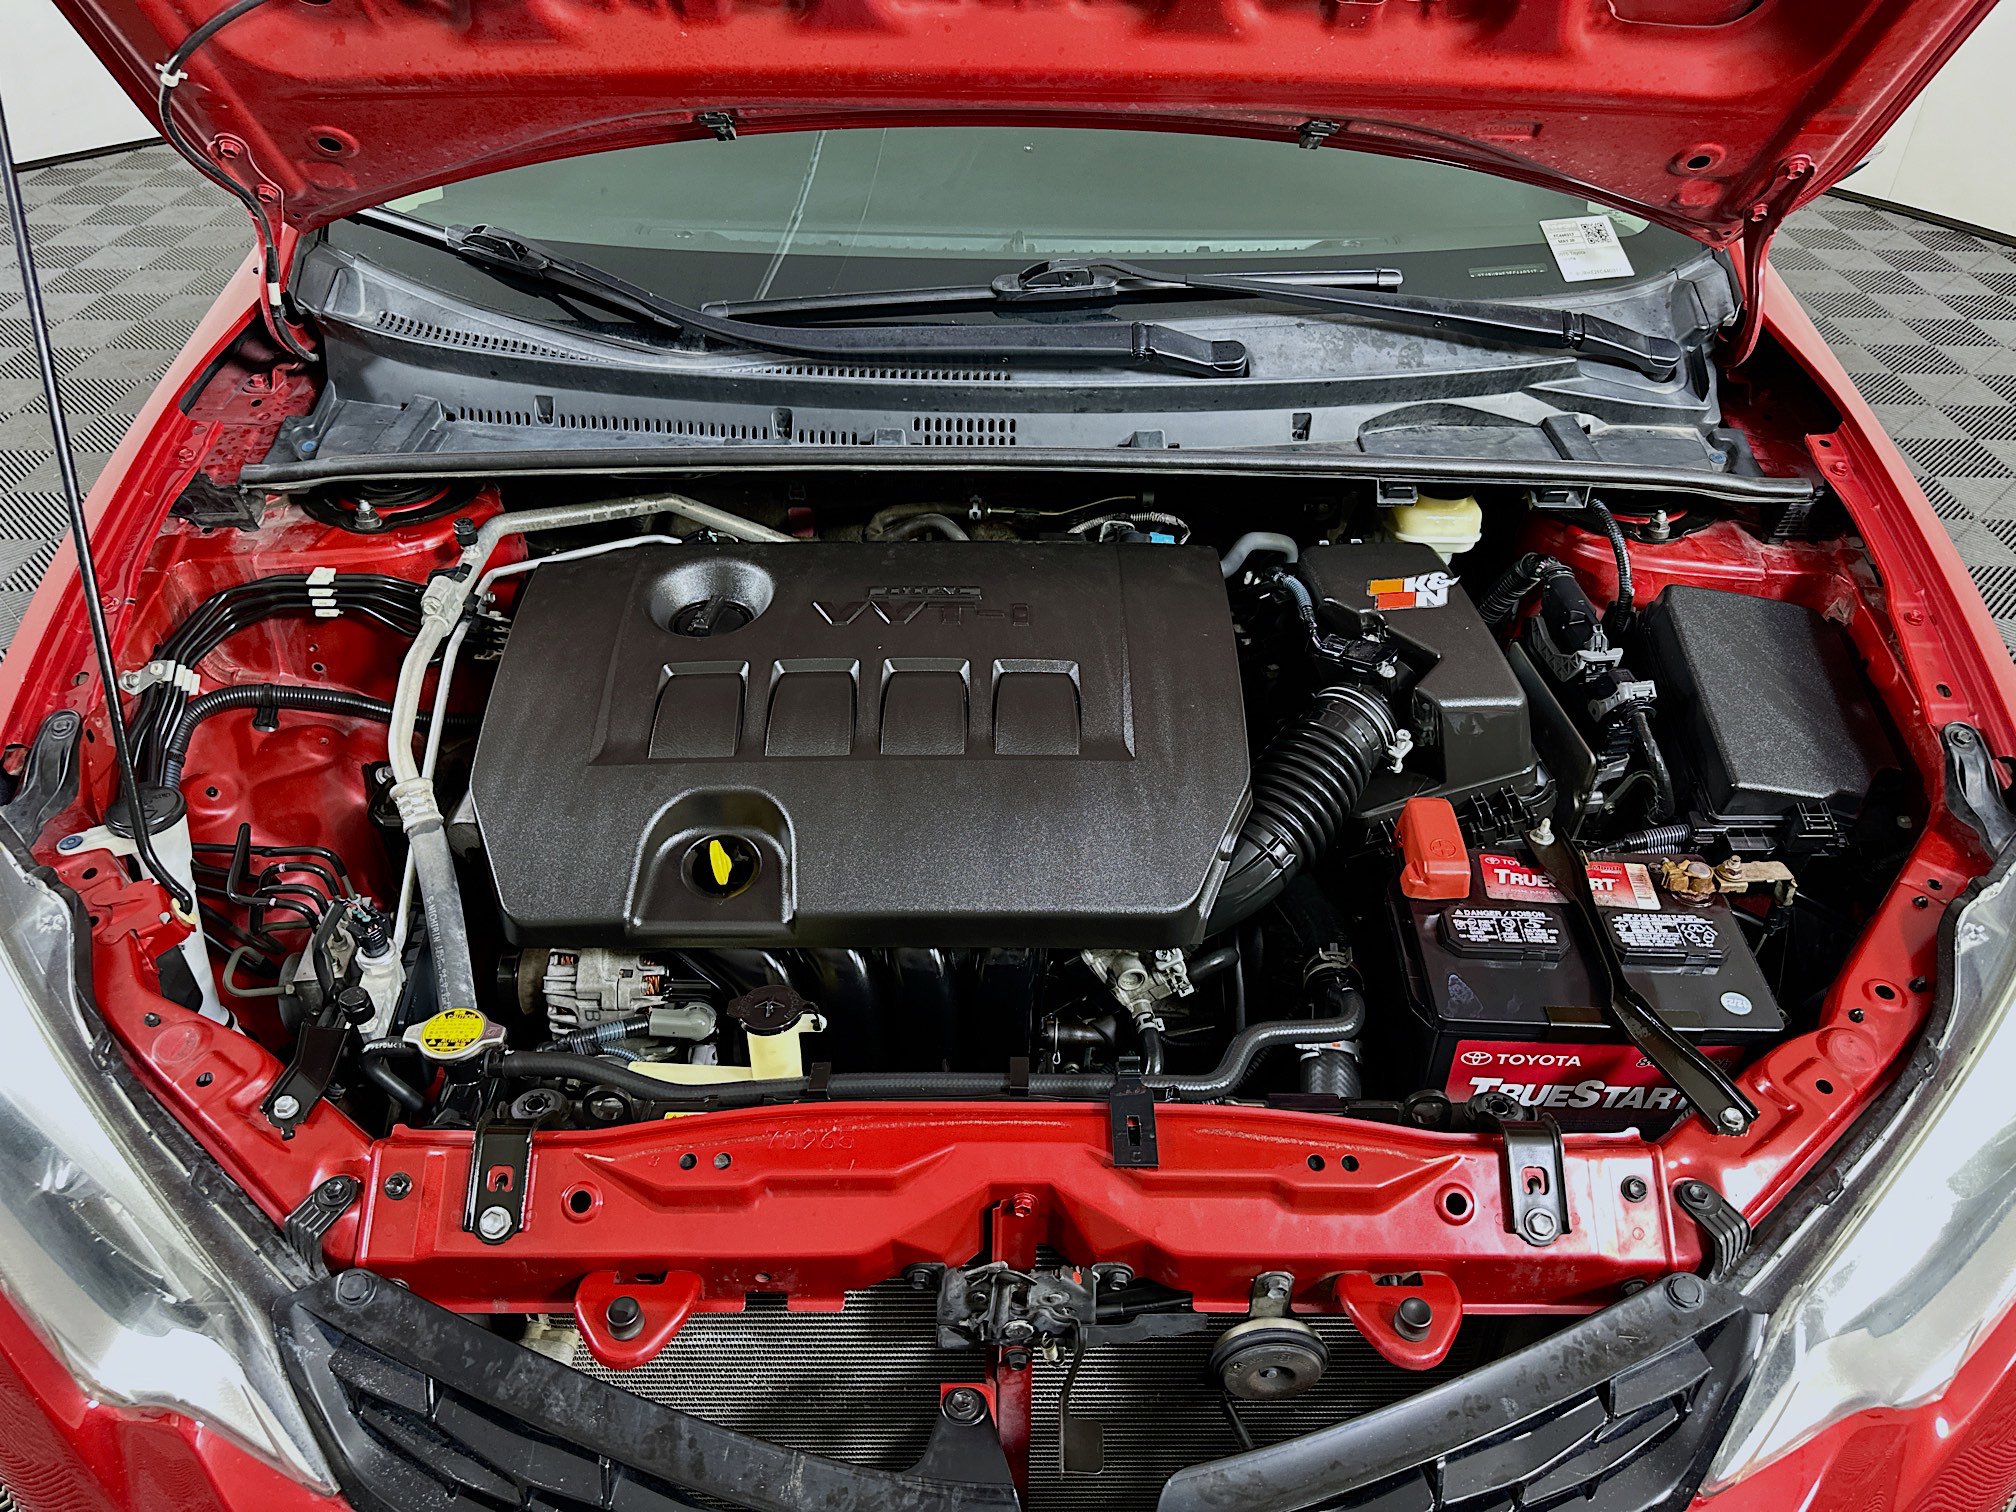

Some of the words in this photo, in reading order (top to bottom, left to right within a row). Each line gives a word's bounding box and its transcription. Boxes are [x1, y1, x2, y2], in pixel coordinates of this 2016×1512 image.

[1463, 909, 1501, 917] DANGER
[1511, 910, 1546, 918] POISON
[1497, 1053, 1582, 1067] TOYOTA
